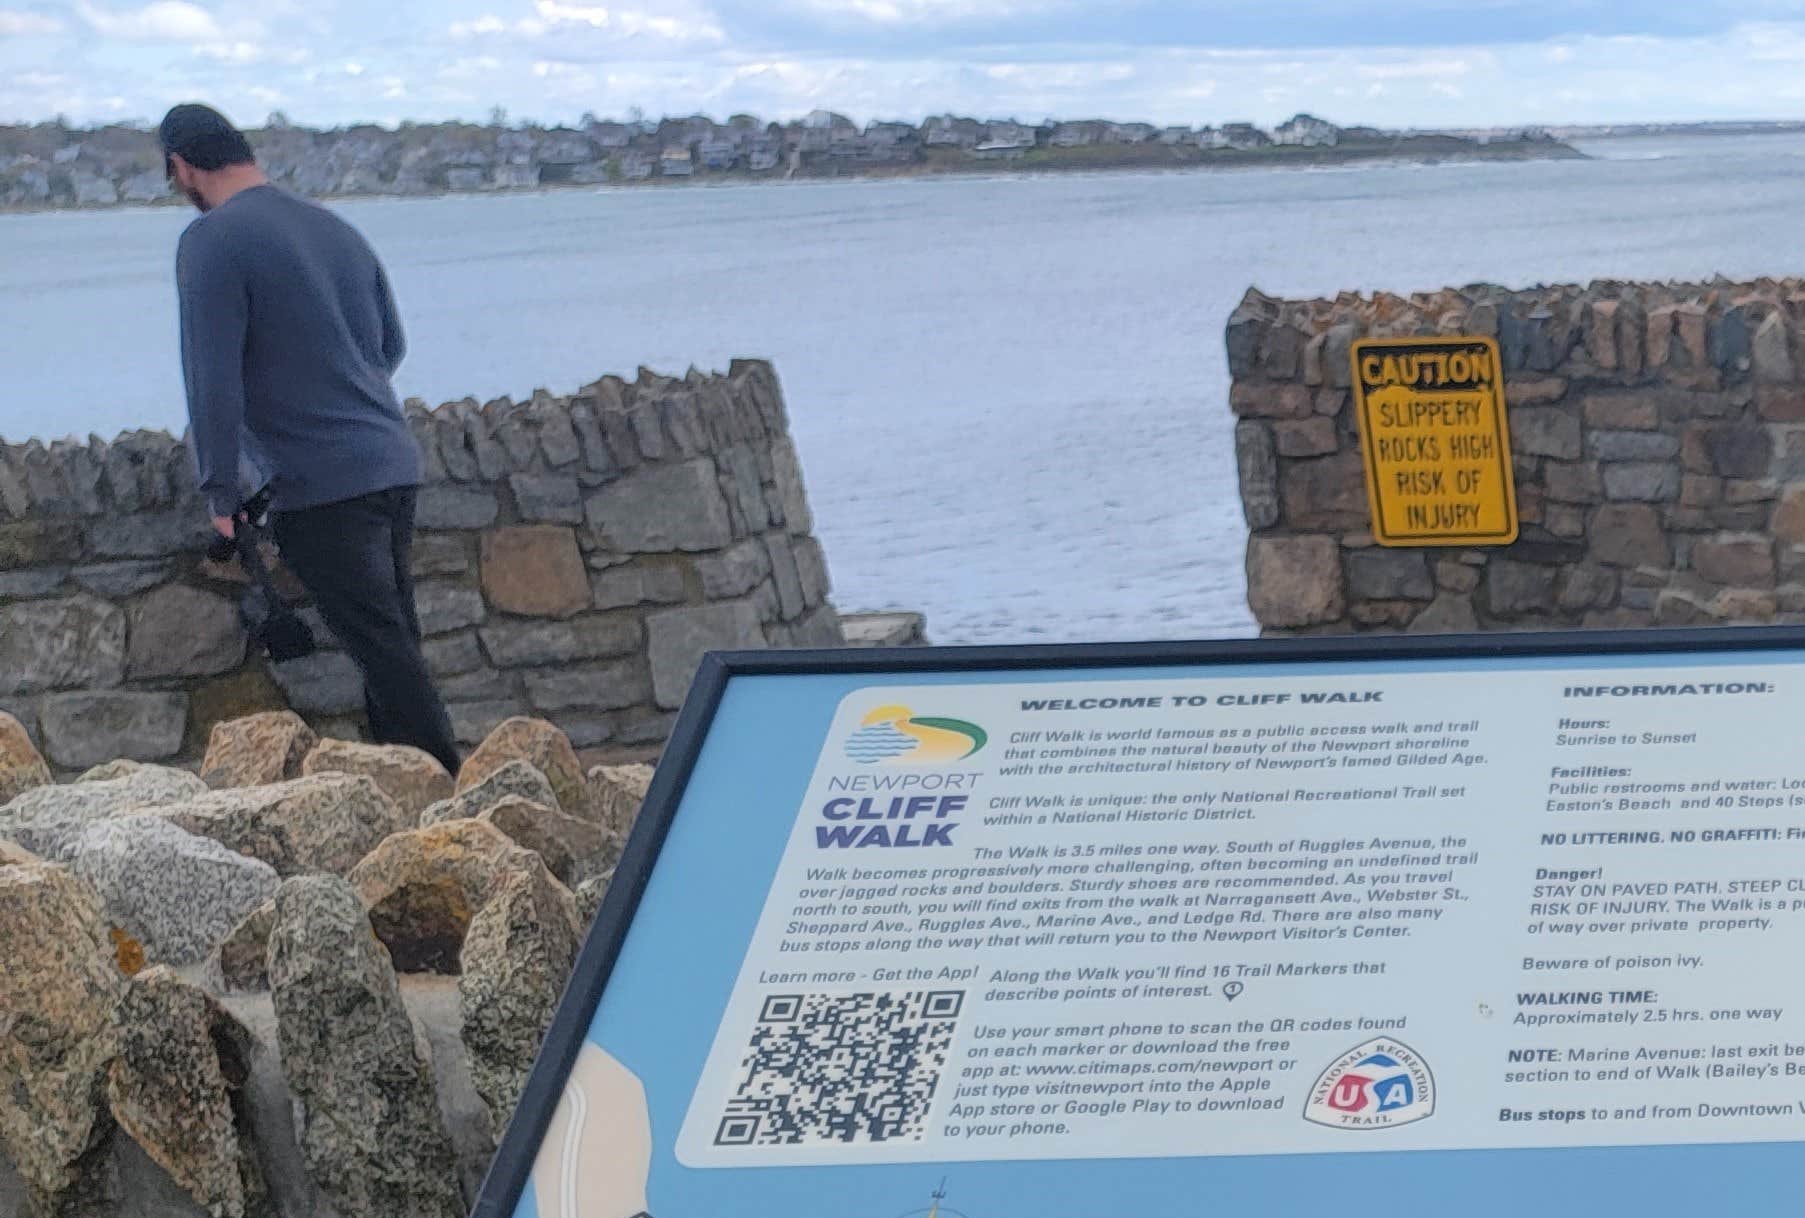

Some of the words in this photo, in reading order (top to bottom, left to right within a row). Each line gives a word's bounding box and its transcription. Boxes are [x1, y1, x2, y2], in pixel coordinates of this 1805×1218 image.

[1362, 351, 1493, 385] CAUTION
[1379, 398, 1482, 428] SLIPPERY
[1378, 435, 1441, 463] ROCKS
[1449, 434, 1494, 463] HIGH
[1394, 471, 1447, 496] RISK
[1455, 469, 1482, 494] OF
[1406, 503, 1481, 530] INJURY
[1563, 681, 1774, 698] INFORMATION:
[1020, 696, 1163, 711] WELCOME
[1171, 694, 1208, 708] TO
[1215, 693, 1292, 707] CLIFF
[1299, 690, 1383, 704] WALK
[1558, 718, 1611, 730] Hours:
[827, 772, 985, 792] NEWPORT
[821, 794, 969, 821] CLIFF
[815, 822, 960, 849] WALK
[1540, 832, 1568, 846] NO
[1669, 830, 1697, 843] NO
[1700, 827, 1782, 843] GRAFFITI:
[1535, 866, 1604, 883] Danger!
[758, 970, 808, 984] Learn
[811, 971, 857, 983] more
[871, 968, 903, 982] Get
[905, 967, 934, 981] the
[936, 964, 980, 982] App!
[1516, 991, 1603, 1006] WALKING
[1608, 989, 1658, 1004] TIME:
